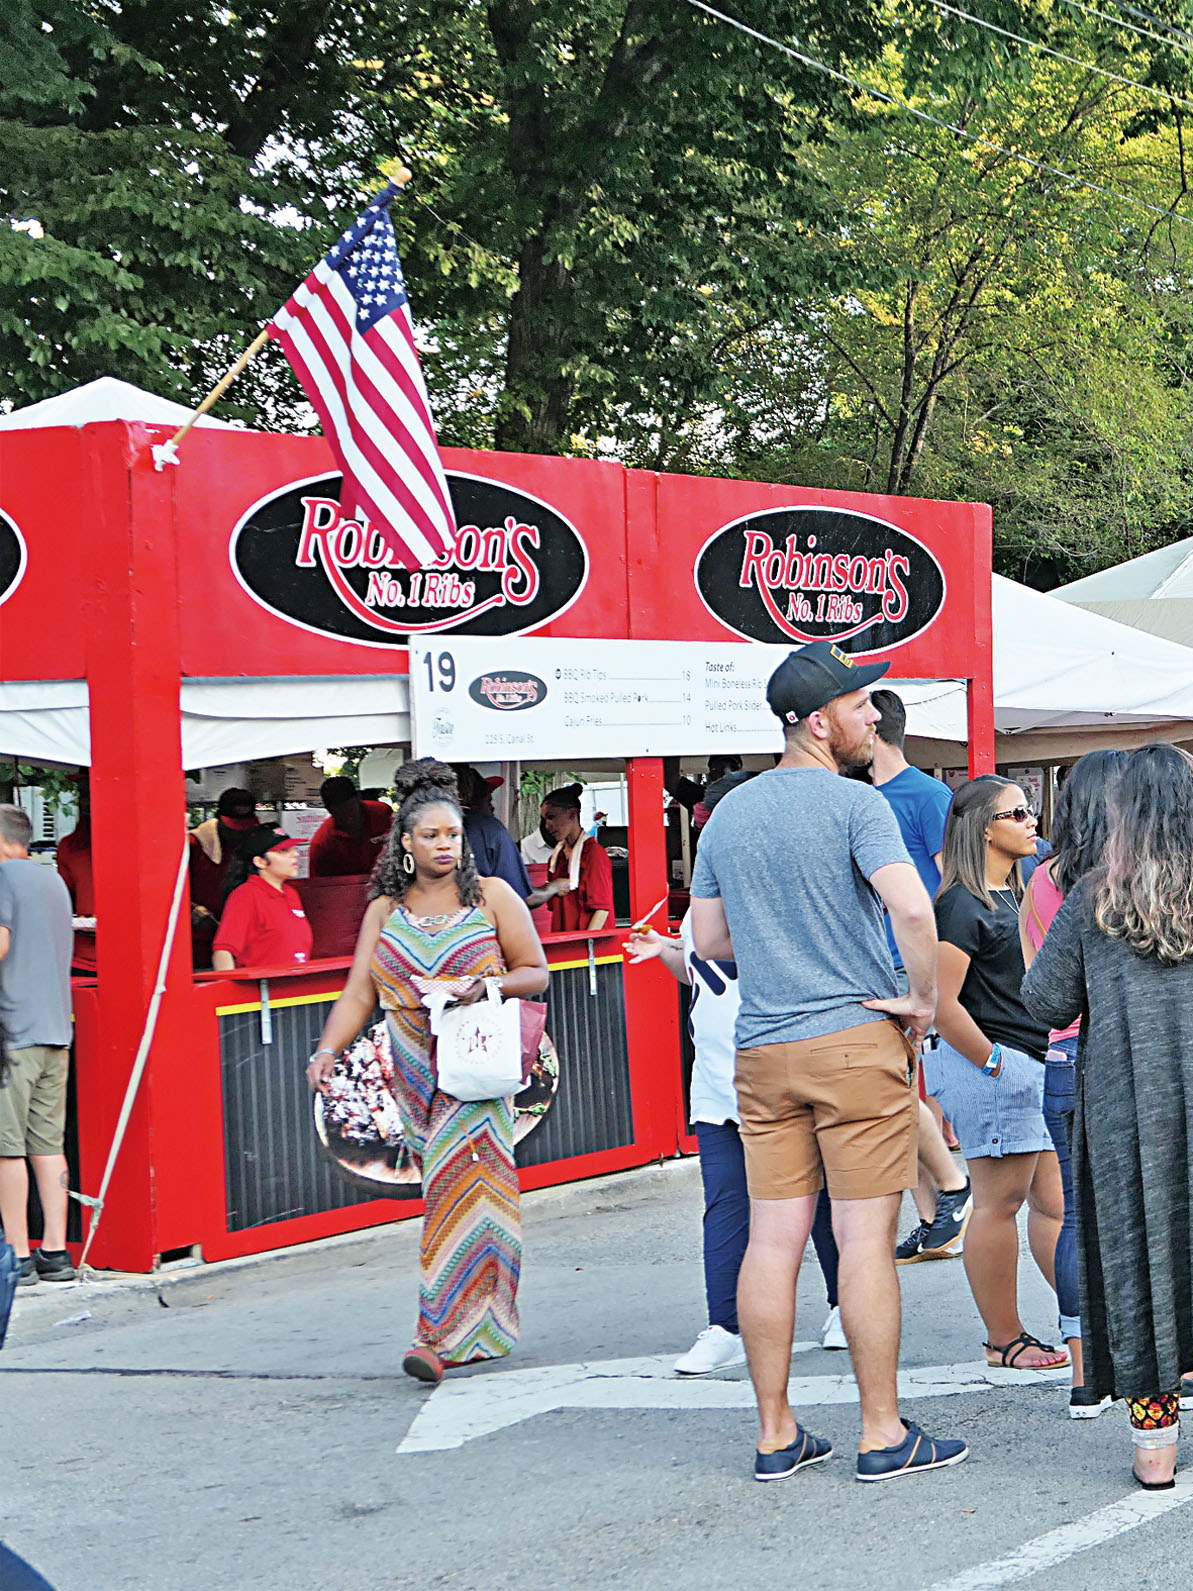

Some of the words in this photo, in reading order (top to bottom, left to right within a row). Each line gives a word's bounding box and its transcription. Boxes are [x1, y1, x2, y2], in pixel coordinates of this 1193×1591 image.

[296, 496, 541, 607] Robon's
[366, 571, 403, 607] No.
[407, 572, 423, 607] 1
[422, 573, 476, 608] Ribs
[739, 530, 911, 624] Robinson's
[787, 591, 813, 622] No.
[815, 593, 826, 623] 1
[826, 594, 863, 624] Ribs
[423, 651, 456, 692] 19
[706, 661, 724, 672] Taste
[705, 699, 727, 710] Pulled
[728, 699, 743, 710] Pork
